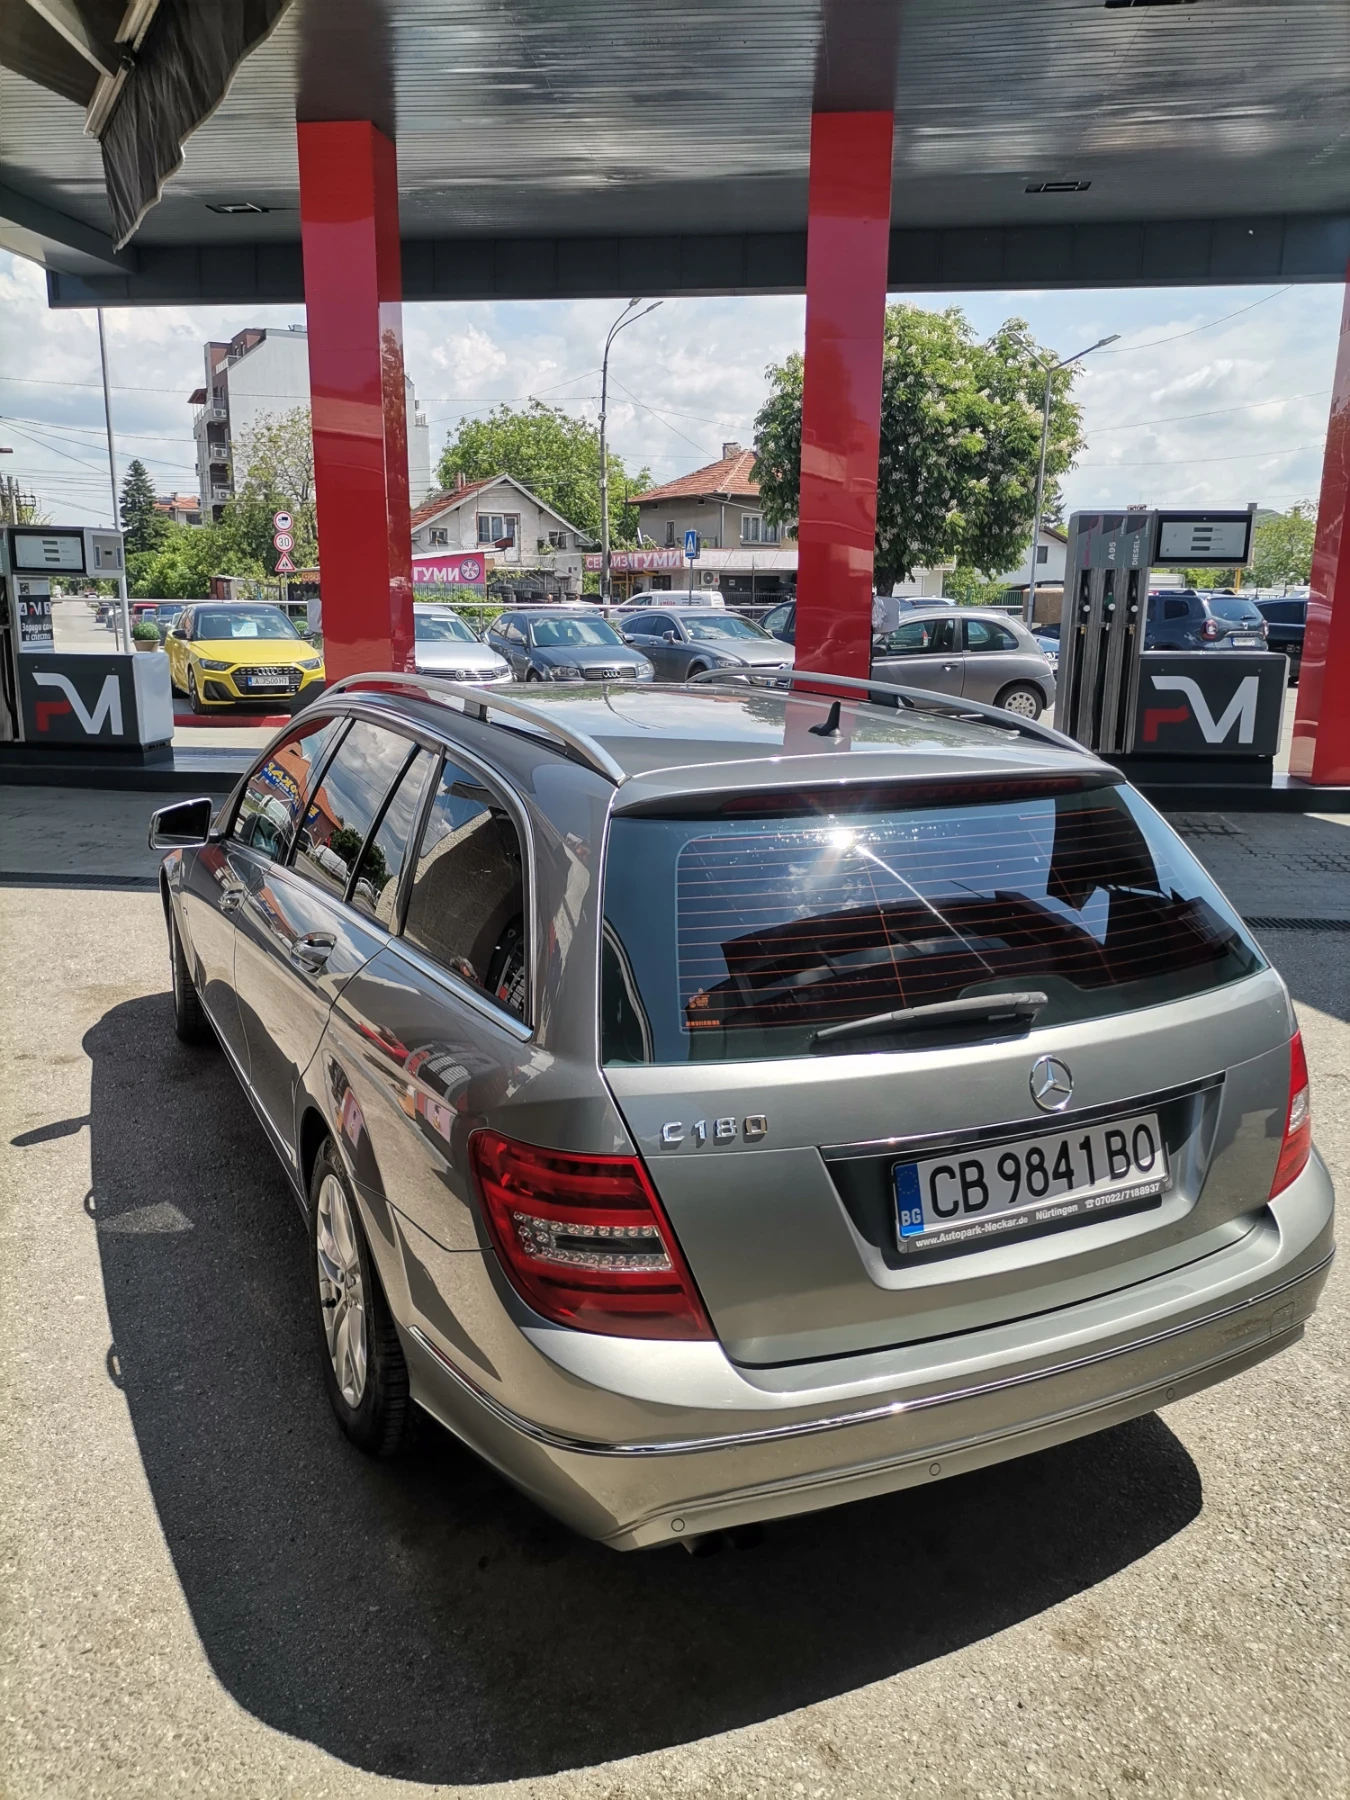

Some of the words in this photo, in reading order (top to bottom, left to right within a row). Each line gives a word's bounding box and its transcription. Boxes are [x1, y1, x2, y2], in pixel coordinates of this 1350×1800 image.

[278, 538, 290, 547] 30
[586, 554, 628, 569] СЕИЗ
[634, 550, 681, 568] ГУМИ
[413, 566, 459, 582] ГУМИ
[929, 1159, 989, 1218] CB
[997, 1135, 1096, 1204] 9841
[1104, 1123, 1156, 1182] BO
[901, 1208, 922, 1227] BG
[915, 1216, 1029, 1248] www.Autopark-Neckar.de
[1035, 1203, 1079, 1220] Nürtingen
